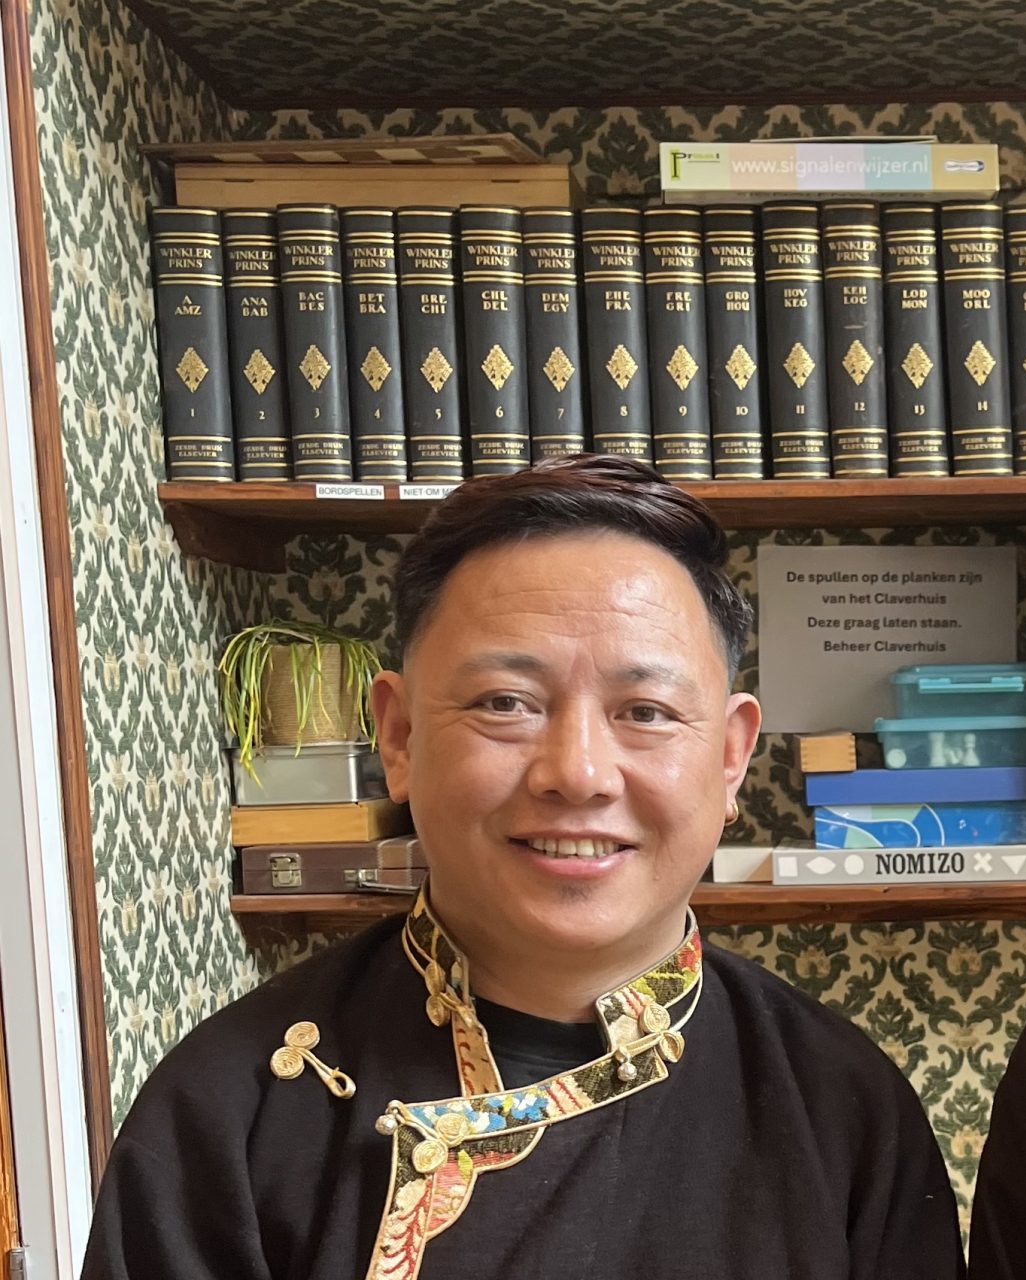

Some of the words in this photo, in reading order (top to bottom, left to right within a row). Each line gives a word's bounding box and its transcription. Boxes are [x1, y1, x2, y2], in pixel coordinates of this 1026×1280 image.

[731, 155, 929, 178] www.signalenwijzer.nl
[284, 246, 333, 256] WINKLER
[468, 246, 518, 256] WINKLER
[770, 244, 818, 254] WINKLER
[829, 242, 877, 251] WINKLER
[888, 246, 936, 255] WINKLER
[950, 243, 998, 253] WINKLER
[160, 248, 212, 259] WINKLER
[836, 252, 869, 261] PRINS
[292, 257, 325, 266] PRINS
[476, 257, 509, 266] PRINS
[600, 257, 633, 266] PRINS
[661, 258, 694, 267] PRINS
[720, 257, 753, 266] PRINS
[778, 255, 811, 264] PRINS
[897, 257, 929, 265] PRINS
[959, 254, 992, 263] PRINS
[169, 259, 202, 268] PRINS
[236, 262, 269, 270] PRINS
[354, 259, 386, 268] PRINS
[415, 259, 448, 268] PRINS
[538, 259, 571, 268] PRINS
[299, 292, 324, 300] BAC
[726, 292, 749, 300] GRO
[903, 290, 928, 299] LOD
[963, 290, 990, 299] MOO
[184, 296, 192, 305] A
[241, 298, 268, 306] ANA
[844, 296, 868, 304] LOC
[902, 300, 927, 309] MON
[964, 300, 990, 309] ORL
[175, 306, 202, 315] AMZ
[360, 304, 386, 313] BRA
[544, 303, 569, 312] EGY
[666, 302, 691, 311] GRI
[242, 307, 268, 317] BAB
[620, 406, 628, 416] 8
[679, 406, 688, 416] 9
[736, 407, 748, 415] 10
[796, 405, 805, 414] 11
[855, 402, 865, 411] 12
[914, 405, 925, 415] 13
[190, 408, 195, 417] 1
[258, 411, 266, 420] 2
[314, 408, 320, 418] 3
[374, 408, 381, 418] 4
[435, 409, 442, 420] 5
[496, 407, 504, 417] 6
[558, 408, 564, 419] 7
[318, 487, 382, 496] BORDSPELLEN
[404, 488, 422, 496] NIET
[426, 488, 440, 496] OM
[786, 572, 805, 583] De
[808, 572, 858, 585] spullen
[862, 574, 879, 585] op
[882, 572, 898, 583] de
[902, 572, 956, 584] planken
[958, 572, 982, 586] zijn
[822, 595, 846, 604] van
[850, 593, 871, 604] het
[874, 592, 947, 604] Claverhuis
[807, 617, 840, 628] Deze
[844, 619, 880, 630] graag
[883, 616, 917, 628] laten
[920, 617, 962, 628] staan.
[824, 640, 870, 652] Beheer
[874, 640, 946, 652] Claverhuis
[876, 852, 965, 874] NOMIZO
